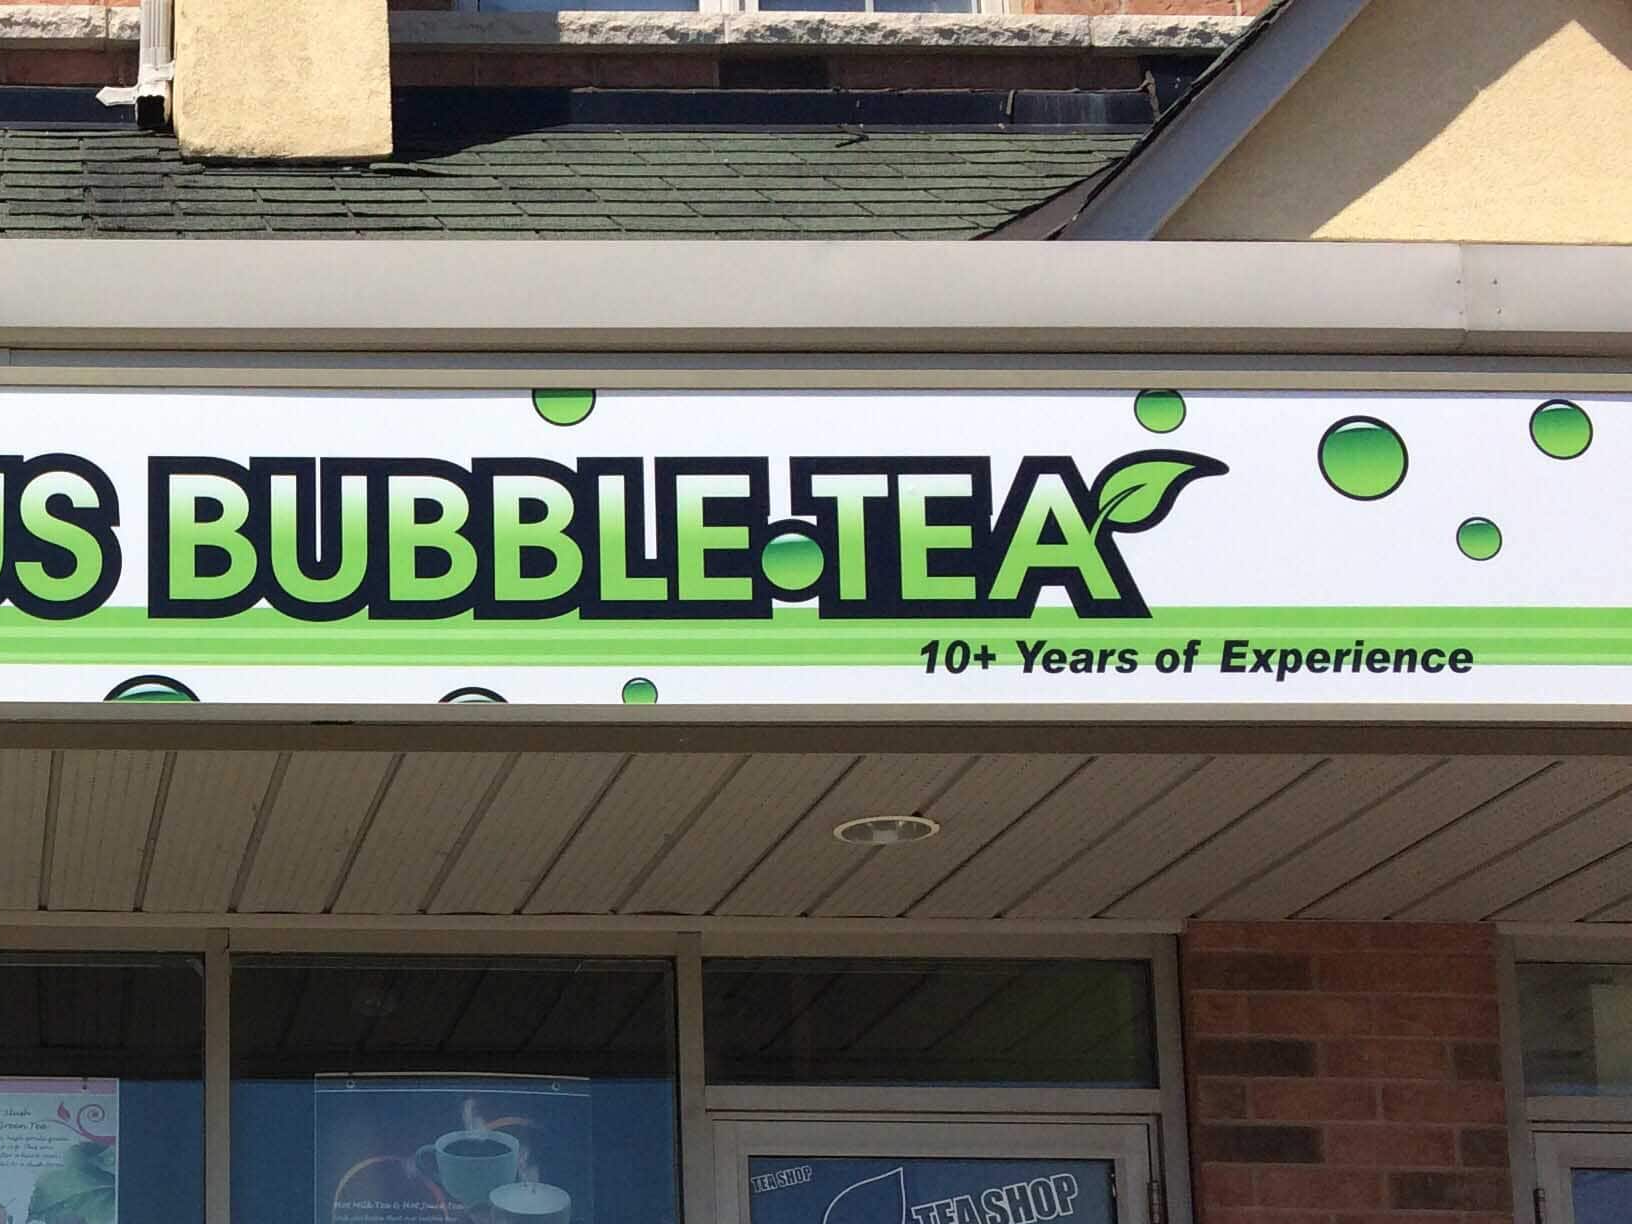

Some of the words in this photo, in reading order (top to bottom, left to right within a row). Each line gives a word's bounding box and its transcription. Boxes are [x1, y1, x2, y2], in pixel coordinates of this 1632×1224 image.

[148, 456, 768, 620] BUBBLE
[785, 456, 1152, 620] TEA
[919, 639, 997, 675] 10+
[1015, 639, 1138, 675] Years
[1155, 639, 1201, 675] of
[1220, 639, 1475, 682] Experience
[751, 1174, 777, 1194] TEA
[777, 1165, 813, 1187] SHOP
